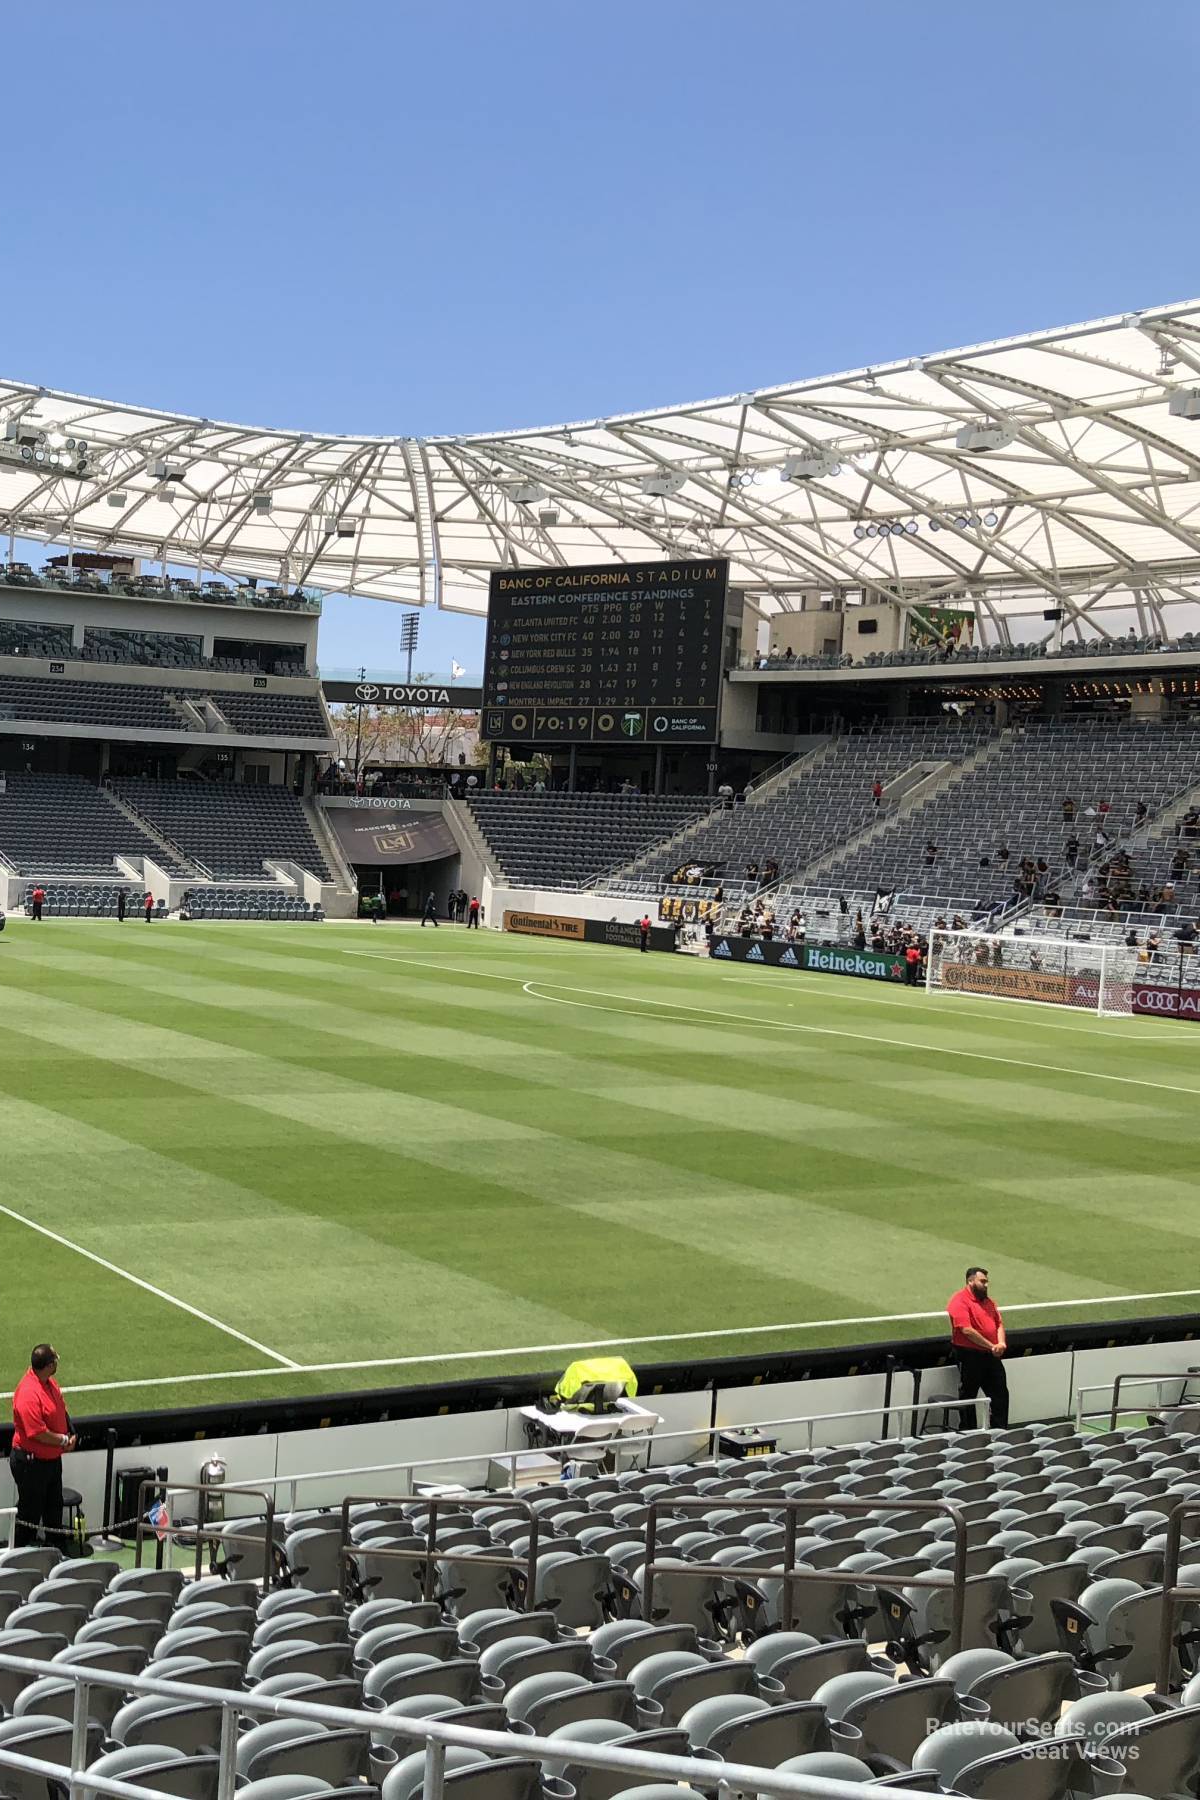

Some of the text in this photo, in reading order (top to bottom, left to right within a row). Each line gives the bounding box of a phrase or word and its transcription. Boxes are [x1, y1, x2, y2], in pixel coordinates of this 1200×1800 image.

[500, 568, 717, 590] BANC OF CALIFORNIA STADIUM
[511, 588, 694, 606] EASTERN CONFERENCE STANDINGS
[582, 600, 710, 613] PTS PPG GP W L T
[513, 619, 542, 627] ATLANTA
[544, 617, 567, 626] UNITED
[569, 617, 578, 625] FC
[584, 616, 594, 624] 40
[602, 615, 622, 624] 2.00
[630, 614, 640, 622] 20
[654, 613, 664, 621] 12
[680, 612, 686, 620] 4
[704, 611, 710, 620] 4
[512, 634, 528, 643] NEW
[529, 634, 548, 642] YORK
[550, 633, 566, 641] CITY
[582, 632, 594, 640] 40
[601, 631, 620, 640] 2.00
[628, 630, 640, 639] 20
[652, 630, 663, 638] 12
[679, 628, 684, 637] 4
[512, 650, 526, 658] NEW
[556, 648, 576, 657] BULLS
[582, 648, 592, 656] 35
[602, 646, 620, 656] 1.94
[629, 646, 639, 655] 18
[652, 646, 662, 655] 11
[678, 645, 684, 654] 5
[702, 644, 708, 653] 2
[511, 665, 545, 674] COLUMBUS
[546, 664, 564, 673] CREW
[566, 664, 575, 672] SC
[580, 664, 592, 672] 30
[600, 664, 618, 672] 1.43
[626, 663, 636, 671] 21
[677, 662, 683, 670] 7
[701, 662, 707, 670] 6
[580, 680, 590, 688] 28
[600, 680, 617, 688] 1.47
[626, 680, 636, 688] 19
[652, 680, 658, 688] 7
[675, 679, 681, 688] 5
[700, 679, 706, 687] 7
[383, 686, 450, 703] TOYOTA
[598, 697, 616, 705] 1.29
[672, 697, 684, 705] 12
[511, 714, 527, 730] 0
[537, 716, 588, 730] 70:19
[598, 714, 614, 731] 0
[367, 799, 411, 808] TOYOTA
[510, 914, 578, 933] Continental TIRE
[605, 924, 618, 932] LOS
[808, 950, 886, 976] Heineken
